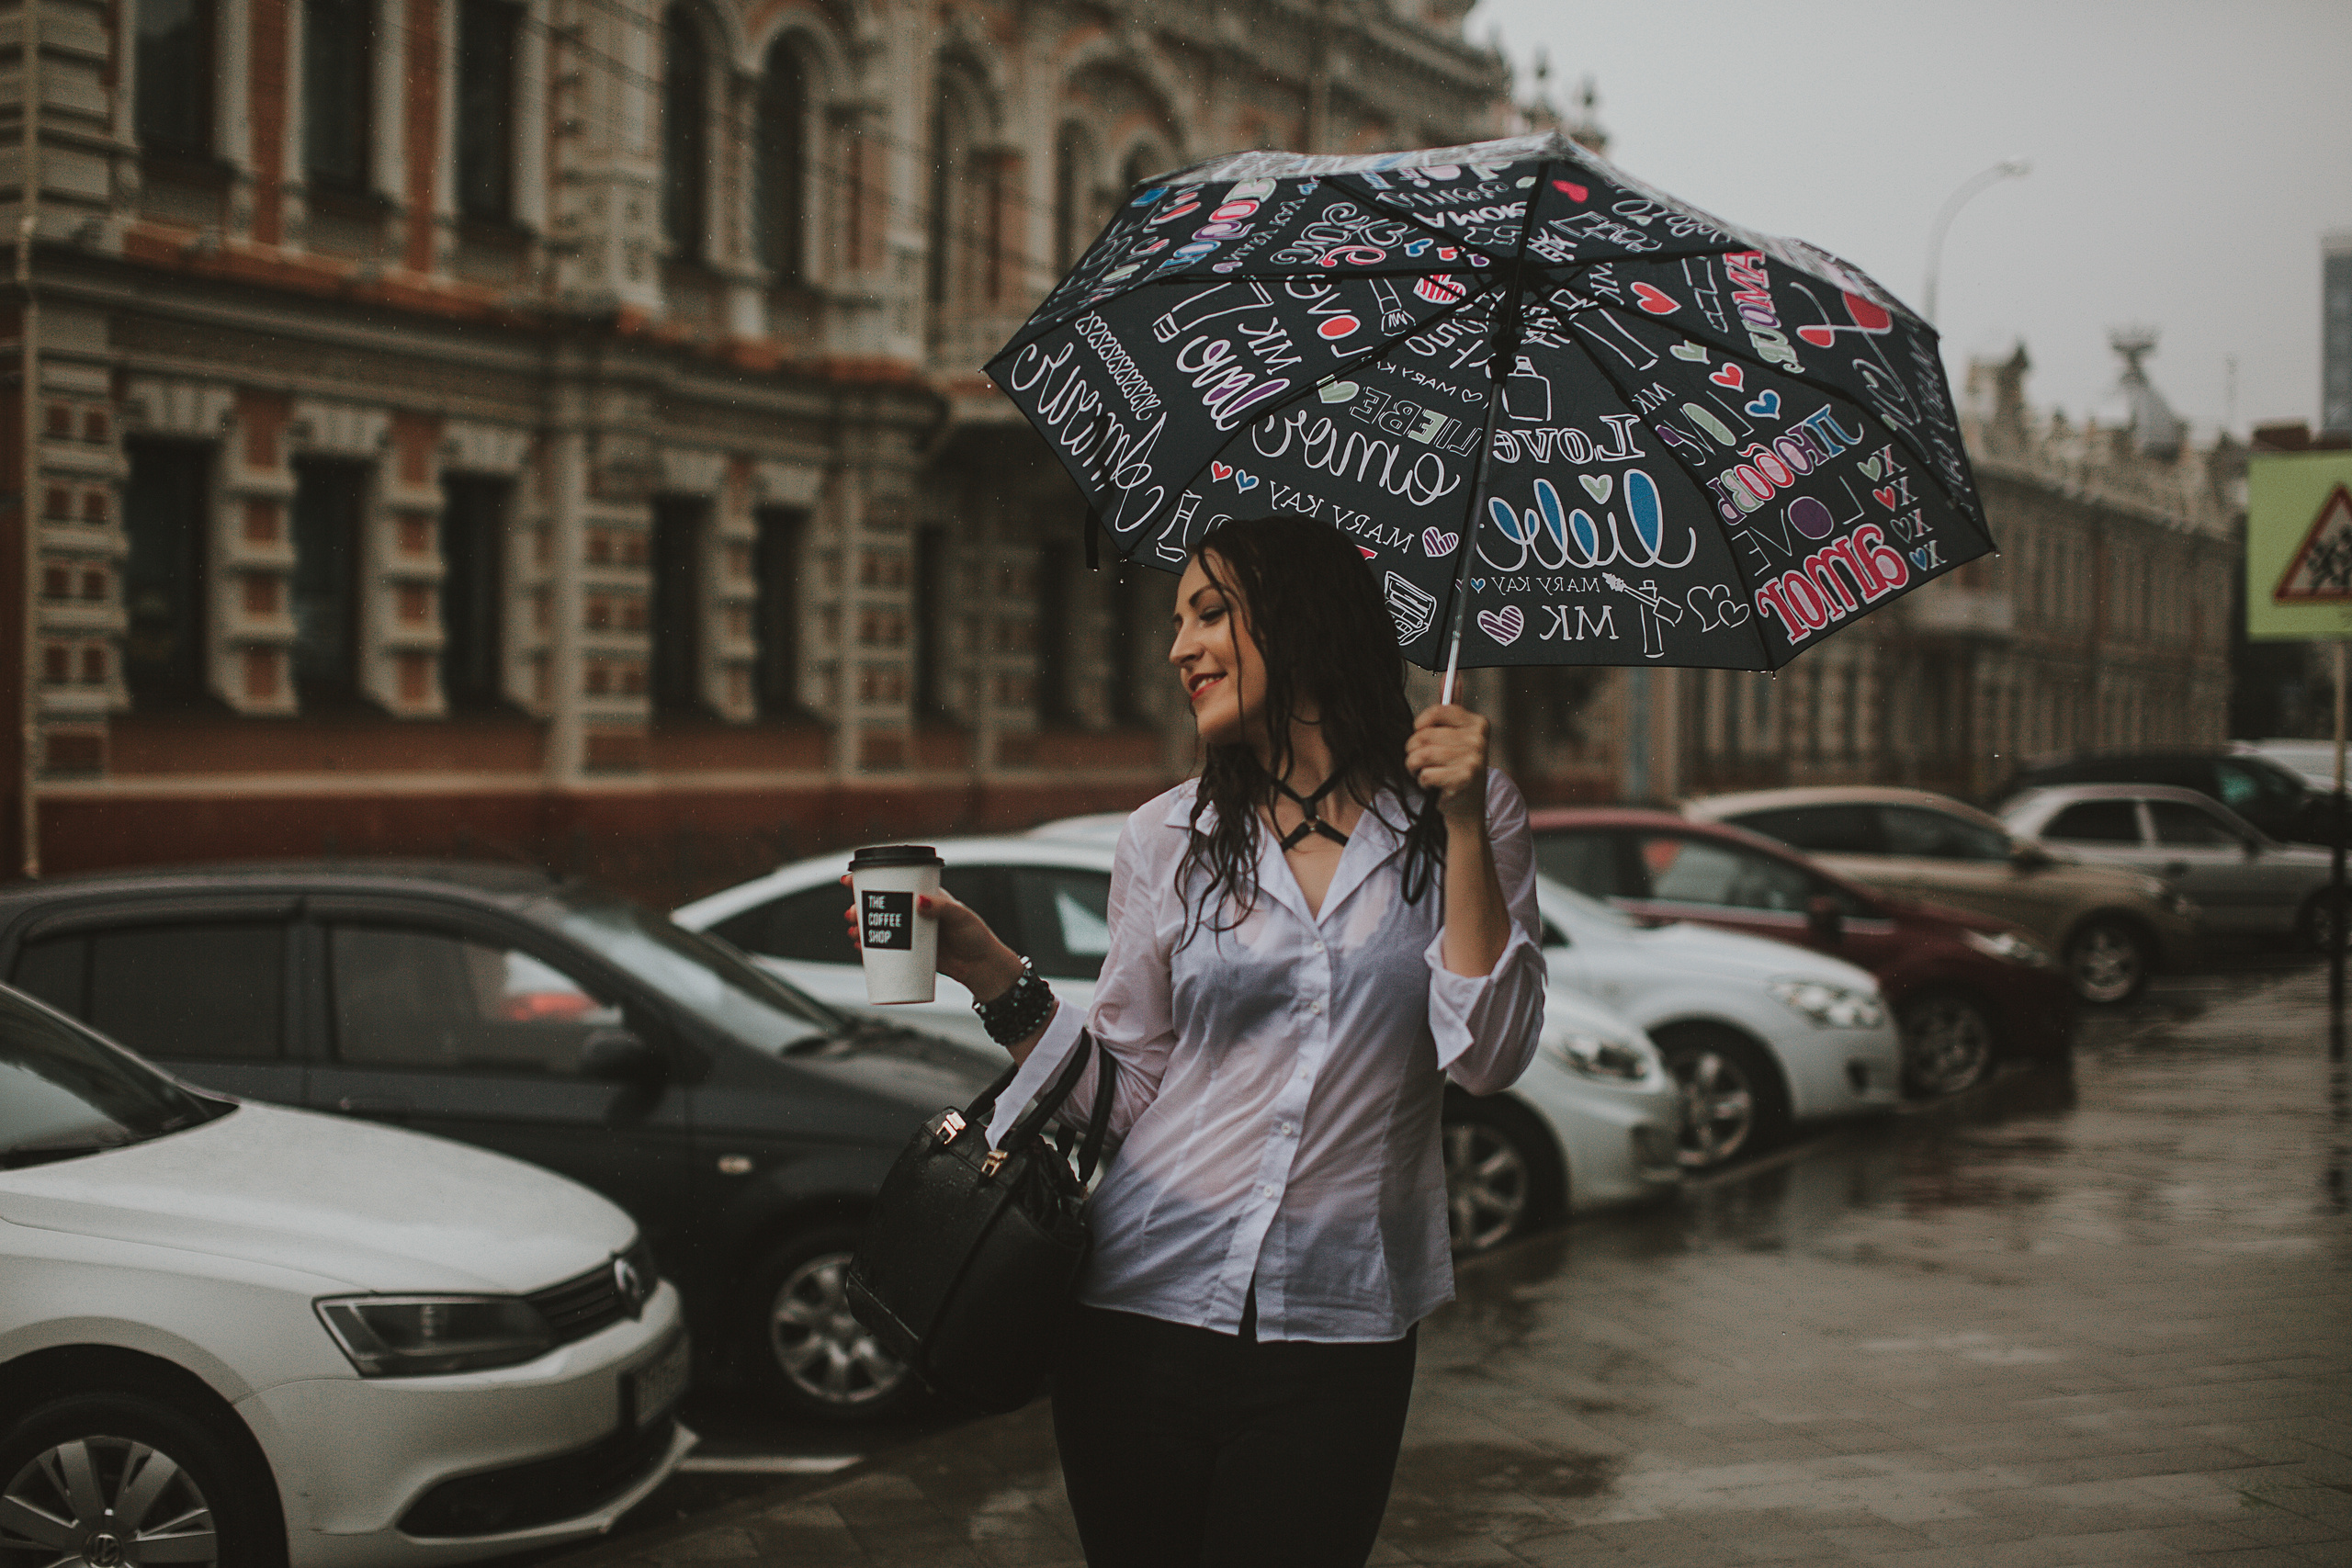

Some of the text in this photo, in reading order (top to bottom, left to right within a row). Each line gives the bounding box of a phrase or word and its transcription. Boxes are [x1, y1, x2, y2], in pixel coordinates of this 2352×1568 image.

[867, 895, 886, 909] THE
[867, 911, 903, 928] COFFEE
[867, 929, 892, 944] SHOP
